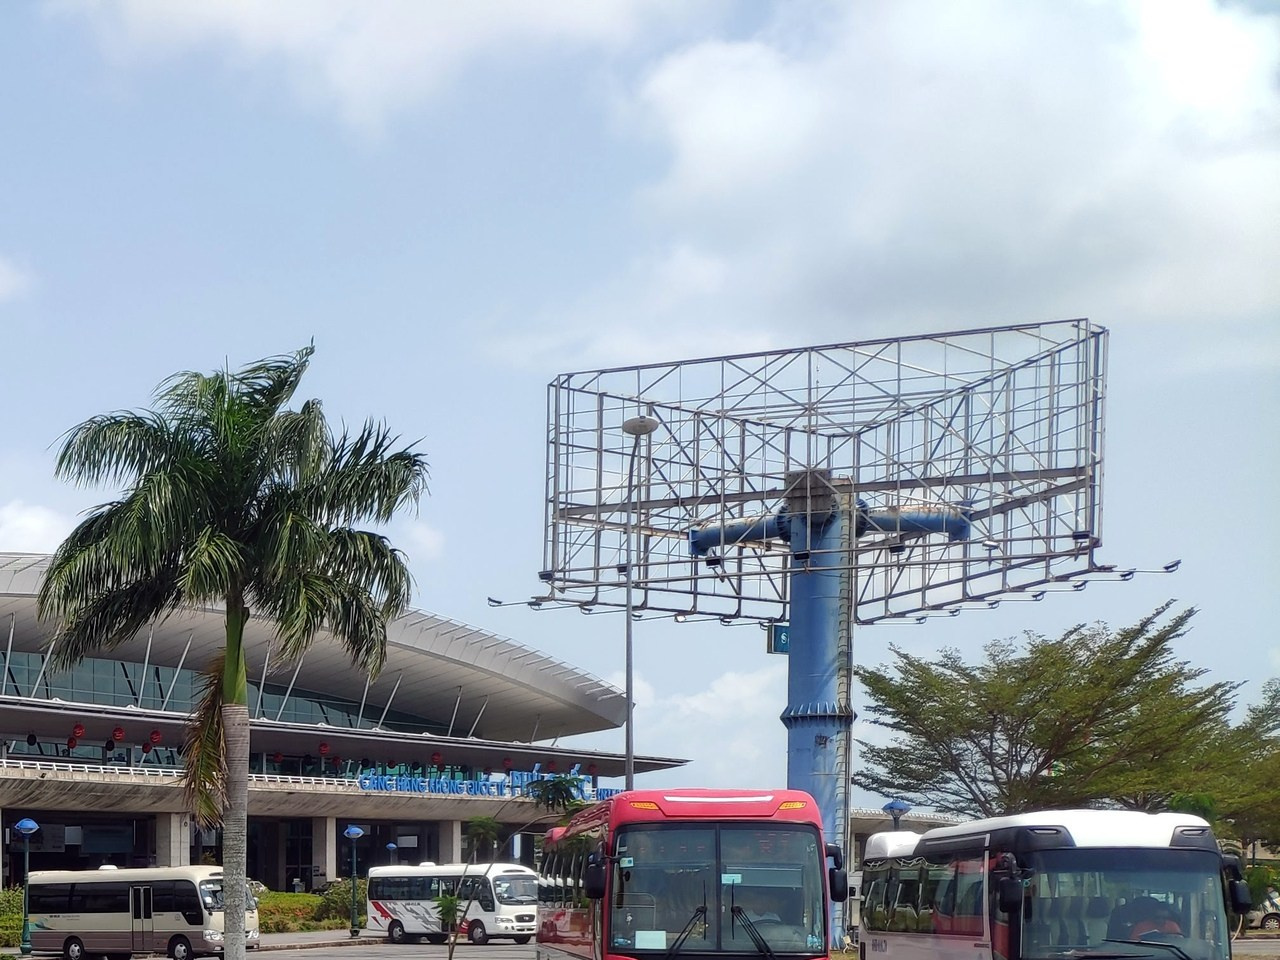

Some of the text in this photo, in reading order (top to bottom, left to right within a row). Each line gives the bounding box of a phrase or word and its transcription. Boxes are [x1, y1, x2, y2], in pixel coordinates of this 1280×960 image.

[360, 767, 394, 791] CẢNG
[395, 771, 427, 793] HÀNG
[428, 775, 465, 795] KHÔNG
[466, 774, 496, 796] QUỐC
